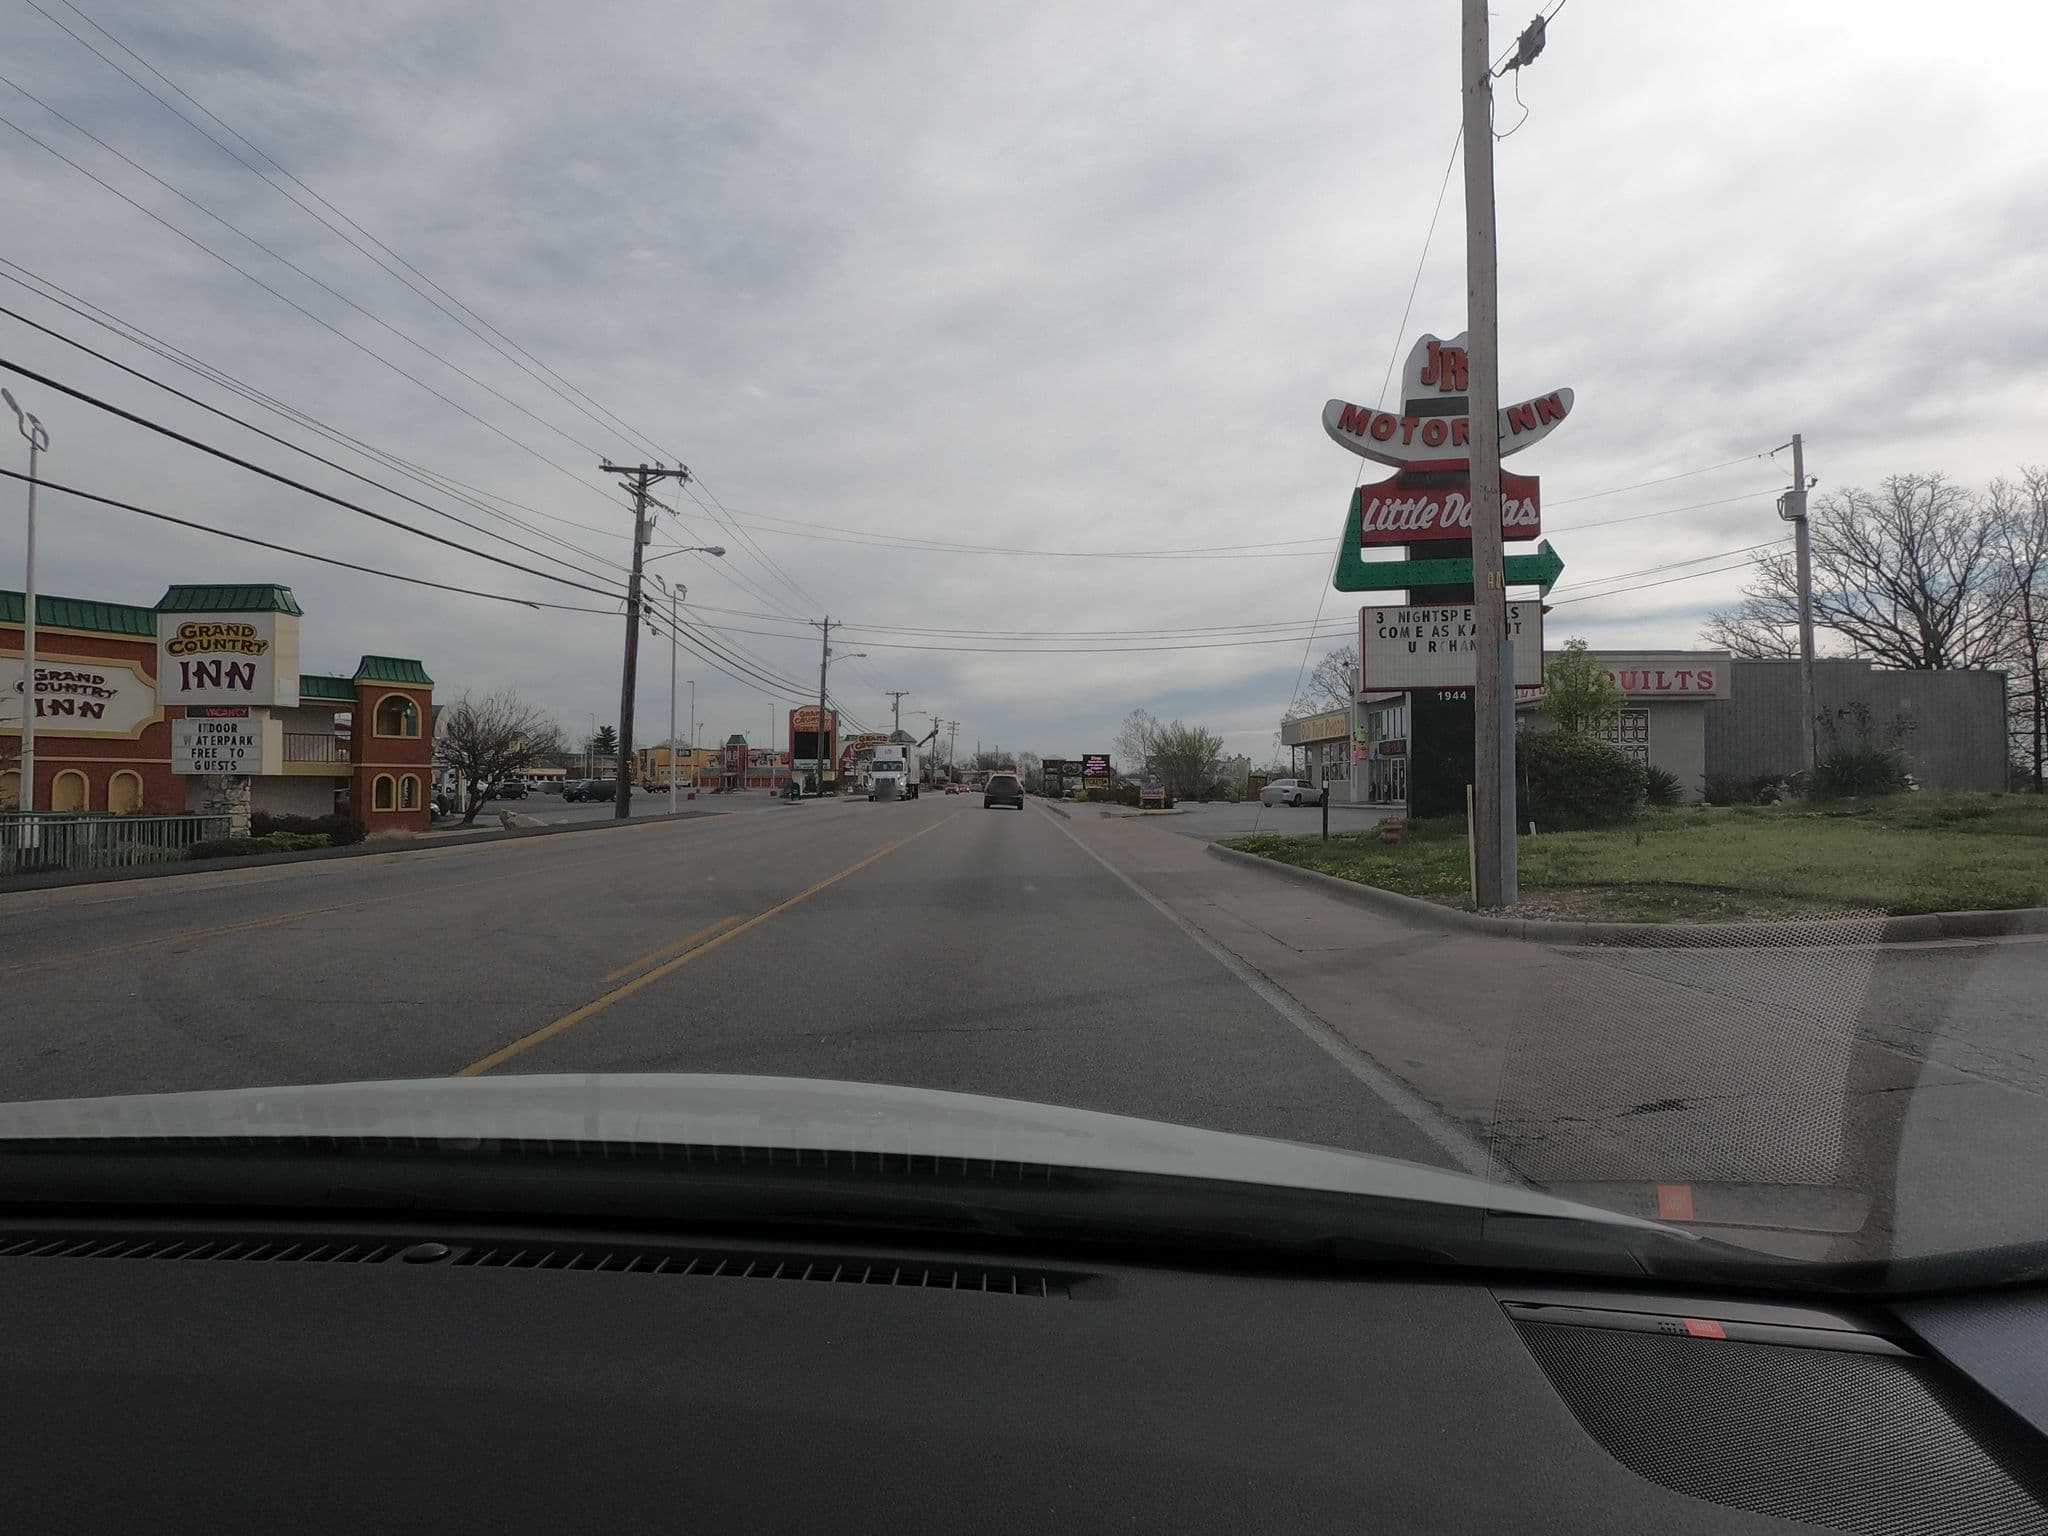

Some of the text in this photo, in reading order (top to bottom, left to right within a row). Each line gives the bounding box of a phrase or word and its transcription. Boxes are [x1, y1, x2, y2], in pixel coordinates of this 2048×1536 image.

[1337, 392, 1567, 447] MOTOR NN
[1363, 496, 1440, 533] Little
[1439, 492, 1540, 530] Daas
[1376, 611, 1385, 624] 3
[179, 623, 256, 639] GRAND
[1378, 622, 1424, 639] COME
[167, 638, 270, 655] COUNTRY
[34, 668, 106, 686] GRAND
[179, 659, 257, 692] INN
[1437, 691, 1467, 701] 1944
[34, 697, 106, 719] INN
[191, 748, 245, 759] FREE TO
[194, 761, 237, 771] GUESTS
